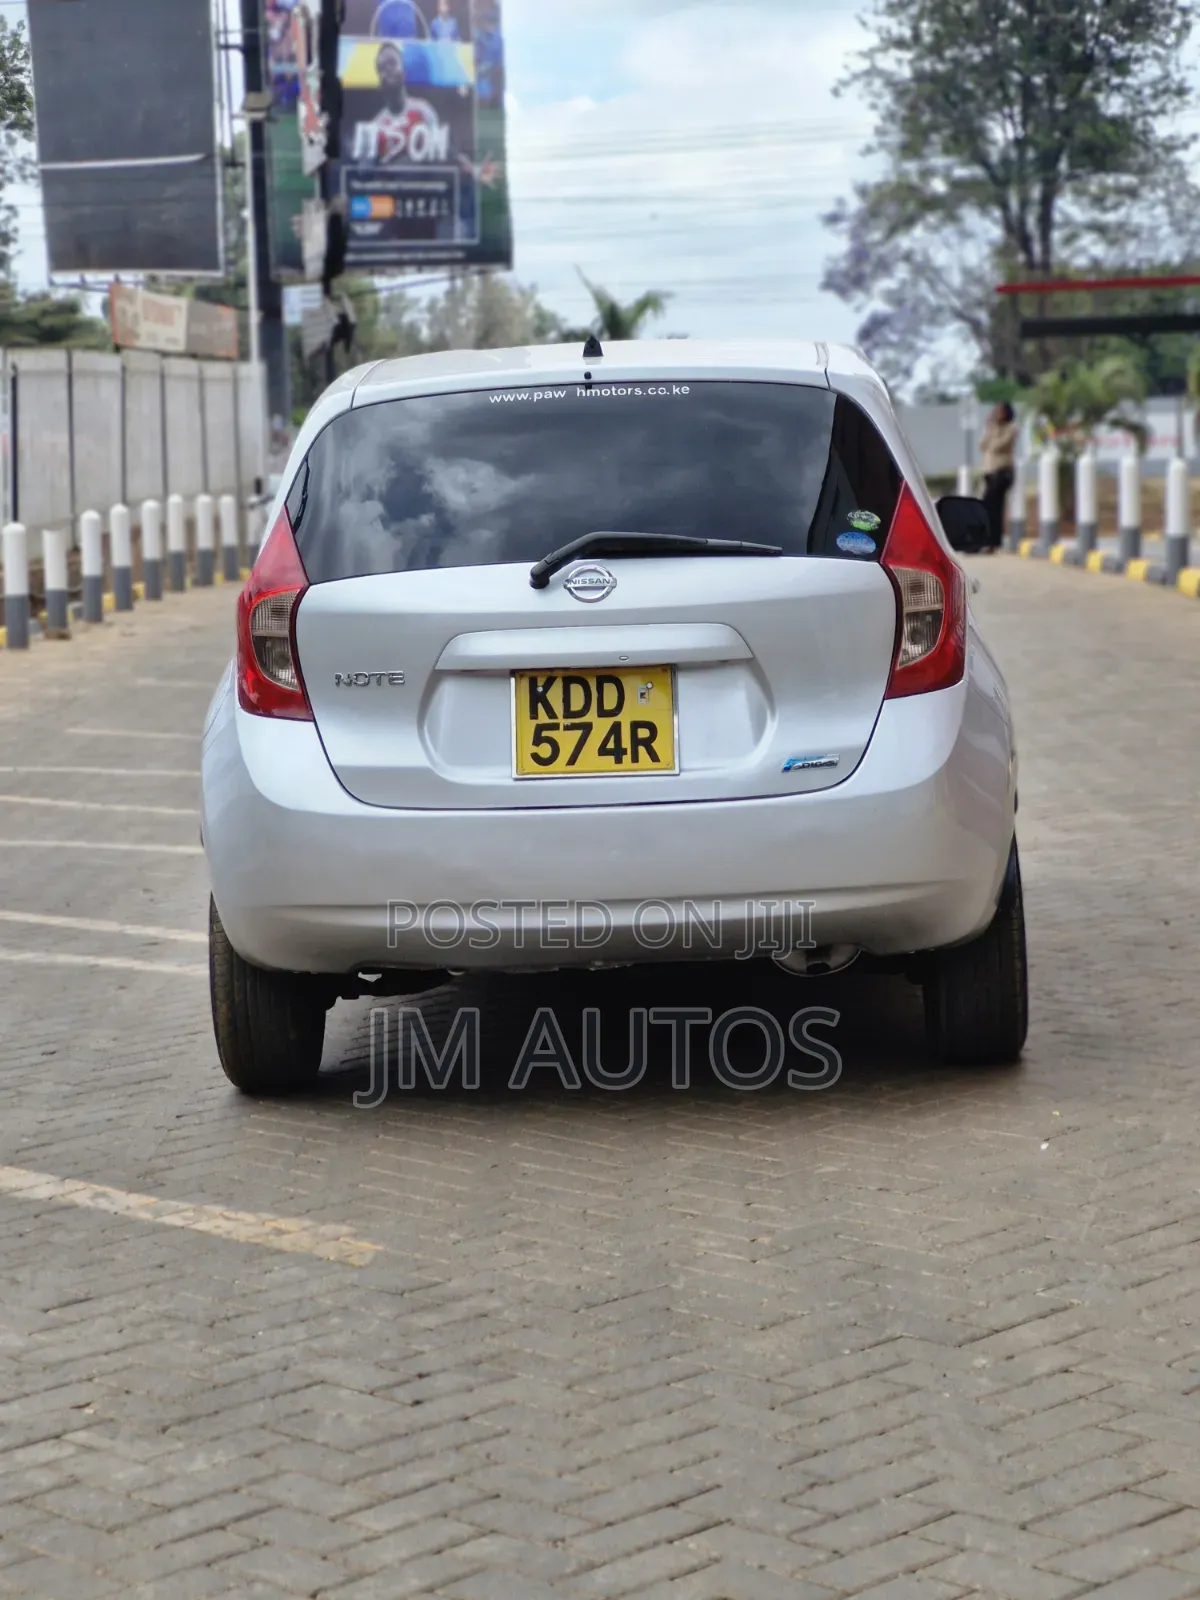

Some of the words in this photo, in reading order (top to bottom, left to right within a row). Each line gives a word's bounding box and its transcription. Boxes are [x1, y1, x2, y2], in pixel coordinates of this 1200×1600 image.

[334, 670, 406, 688] NOTE
[528, 674, 626, 720] KDD
[529, 720, 661, 767] 574R
